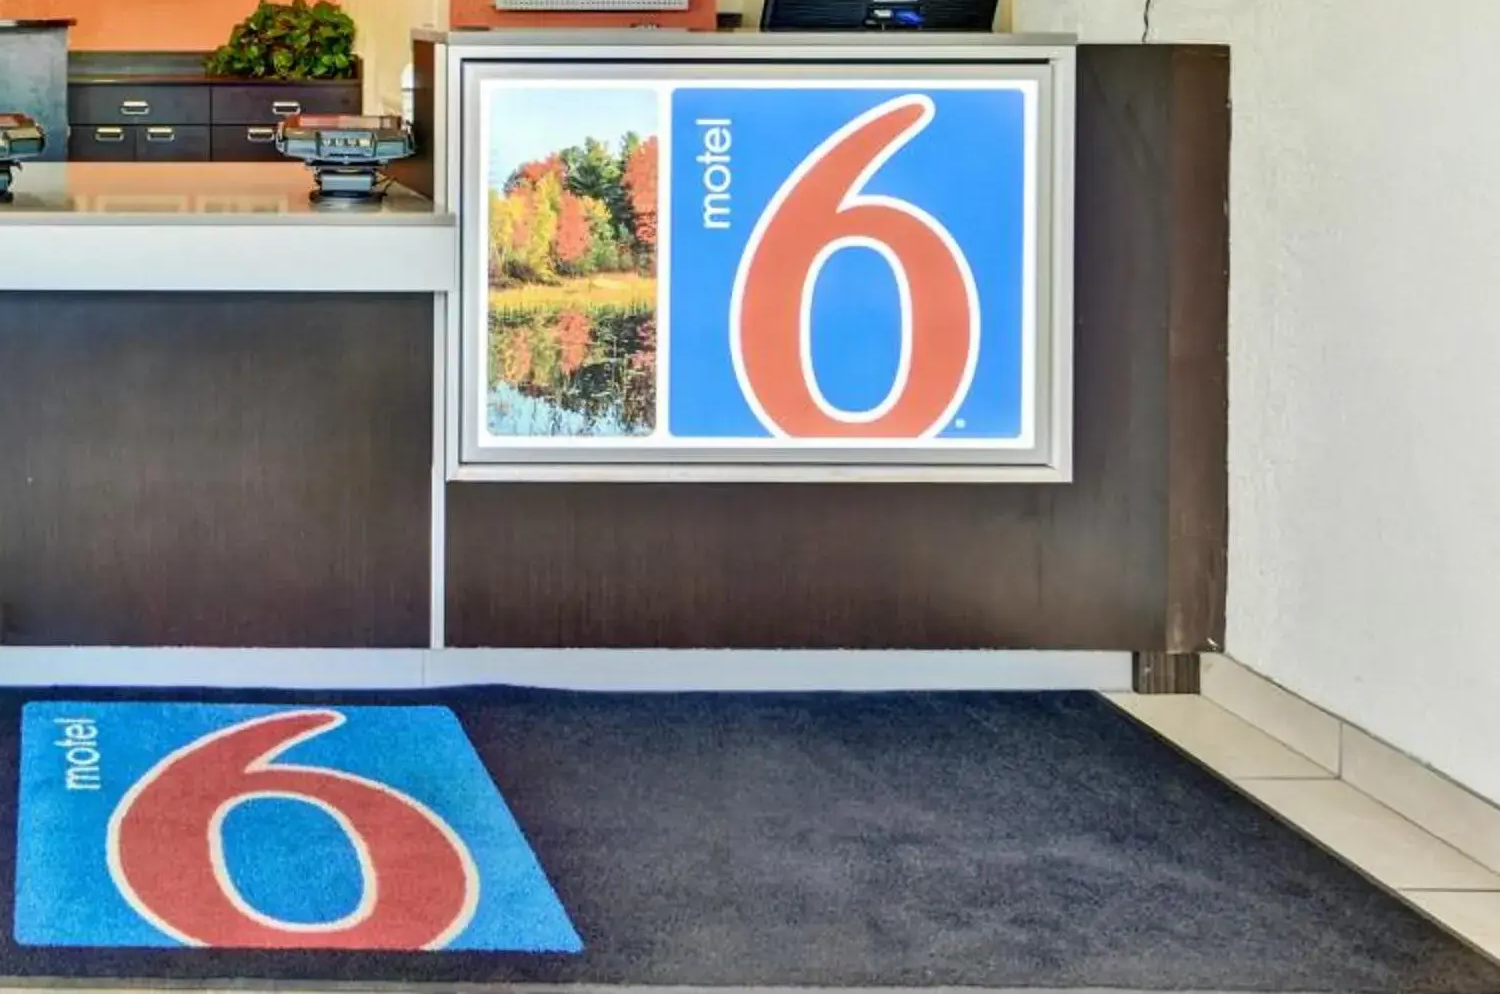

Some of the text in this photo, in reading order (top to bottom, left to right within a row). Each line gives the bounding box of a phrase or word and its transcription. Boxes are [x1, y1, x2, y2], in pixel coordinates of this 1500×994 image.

[695, 118, 732, 229] motel
[729, 93, 981, 438] 6
[54, 717, 100, 790] motel
[105, 709, 480, 949] 6
